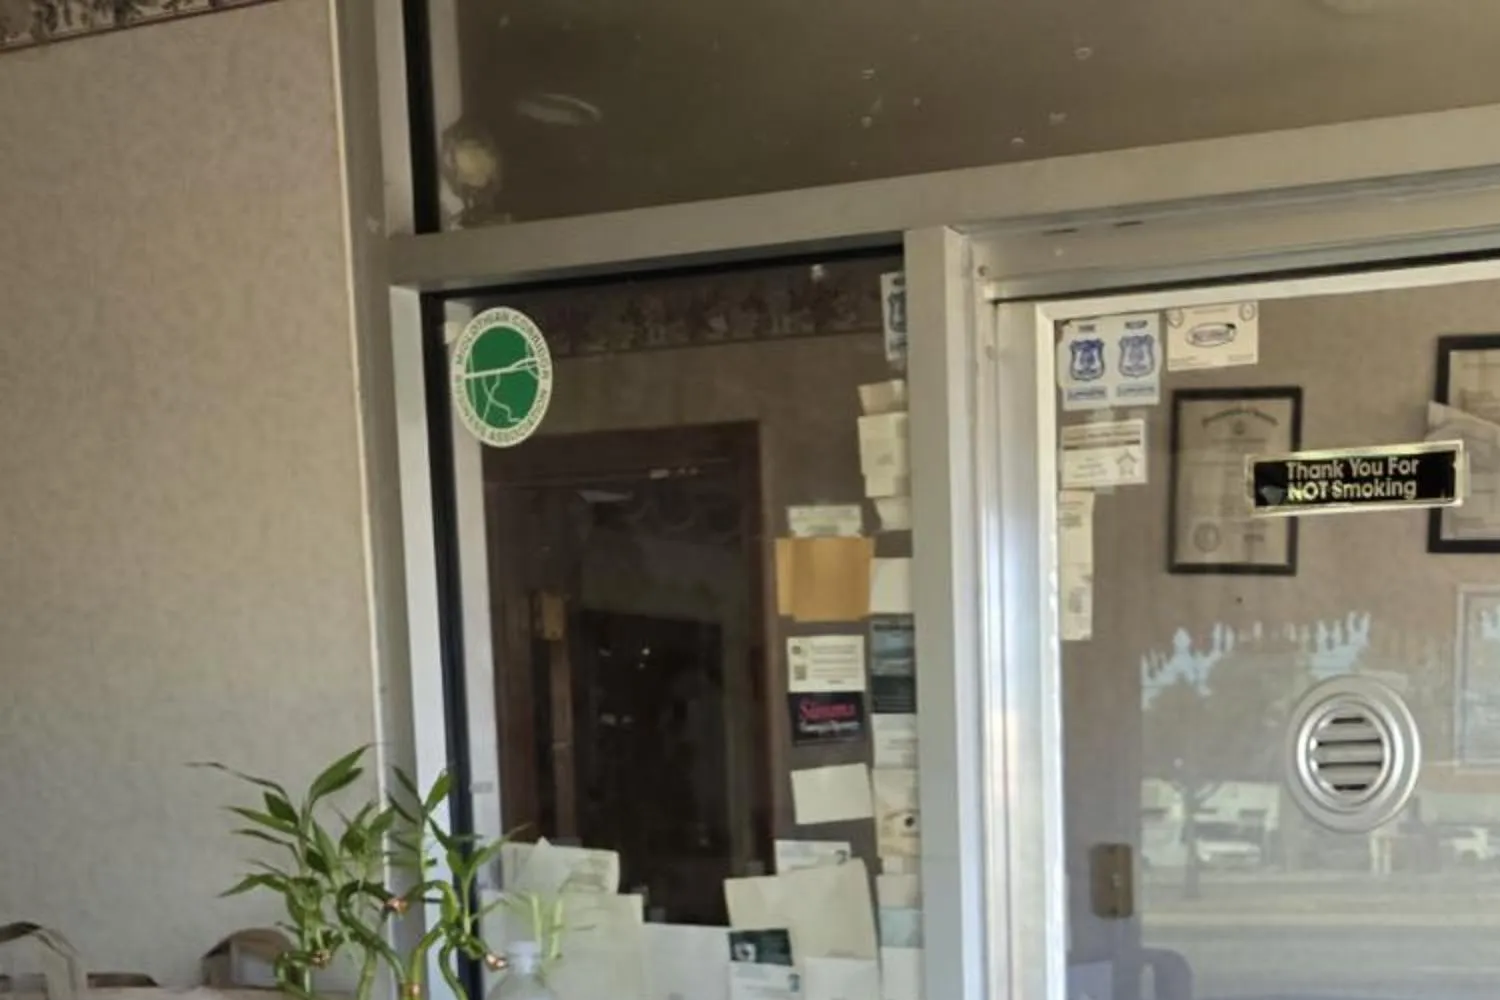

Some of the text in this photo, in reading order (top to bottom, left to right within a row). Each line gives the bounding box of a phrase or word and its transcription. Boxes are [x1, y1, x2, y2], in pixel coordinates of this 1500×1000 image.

[1286, 456, 1420, 480] Thank You For
[1287, 479, 1417, 501] NOT Smoking
